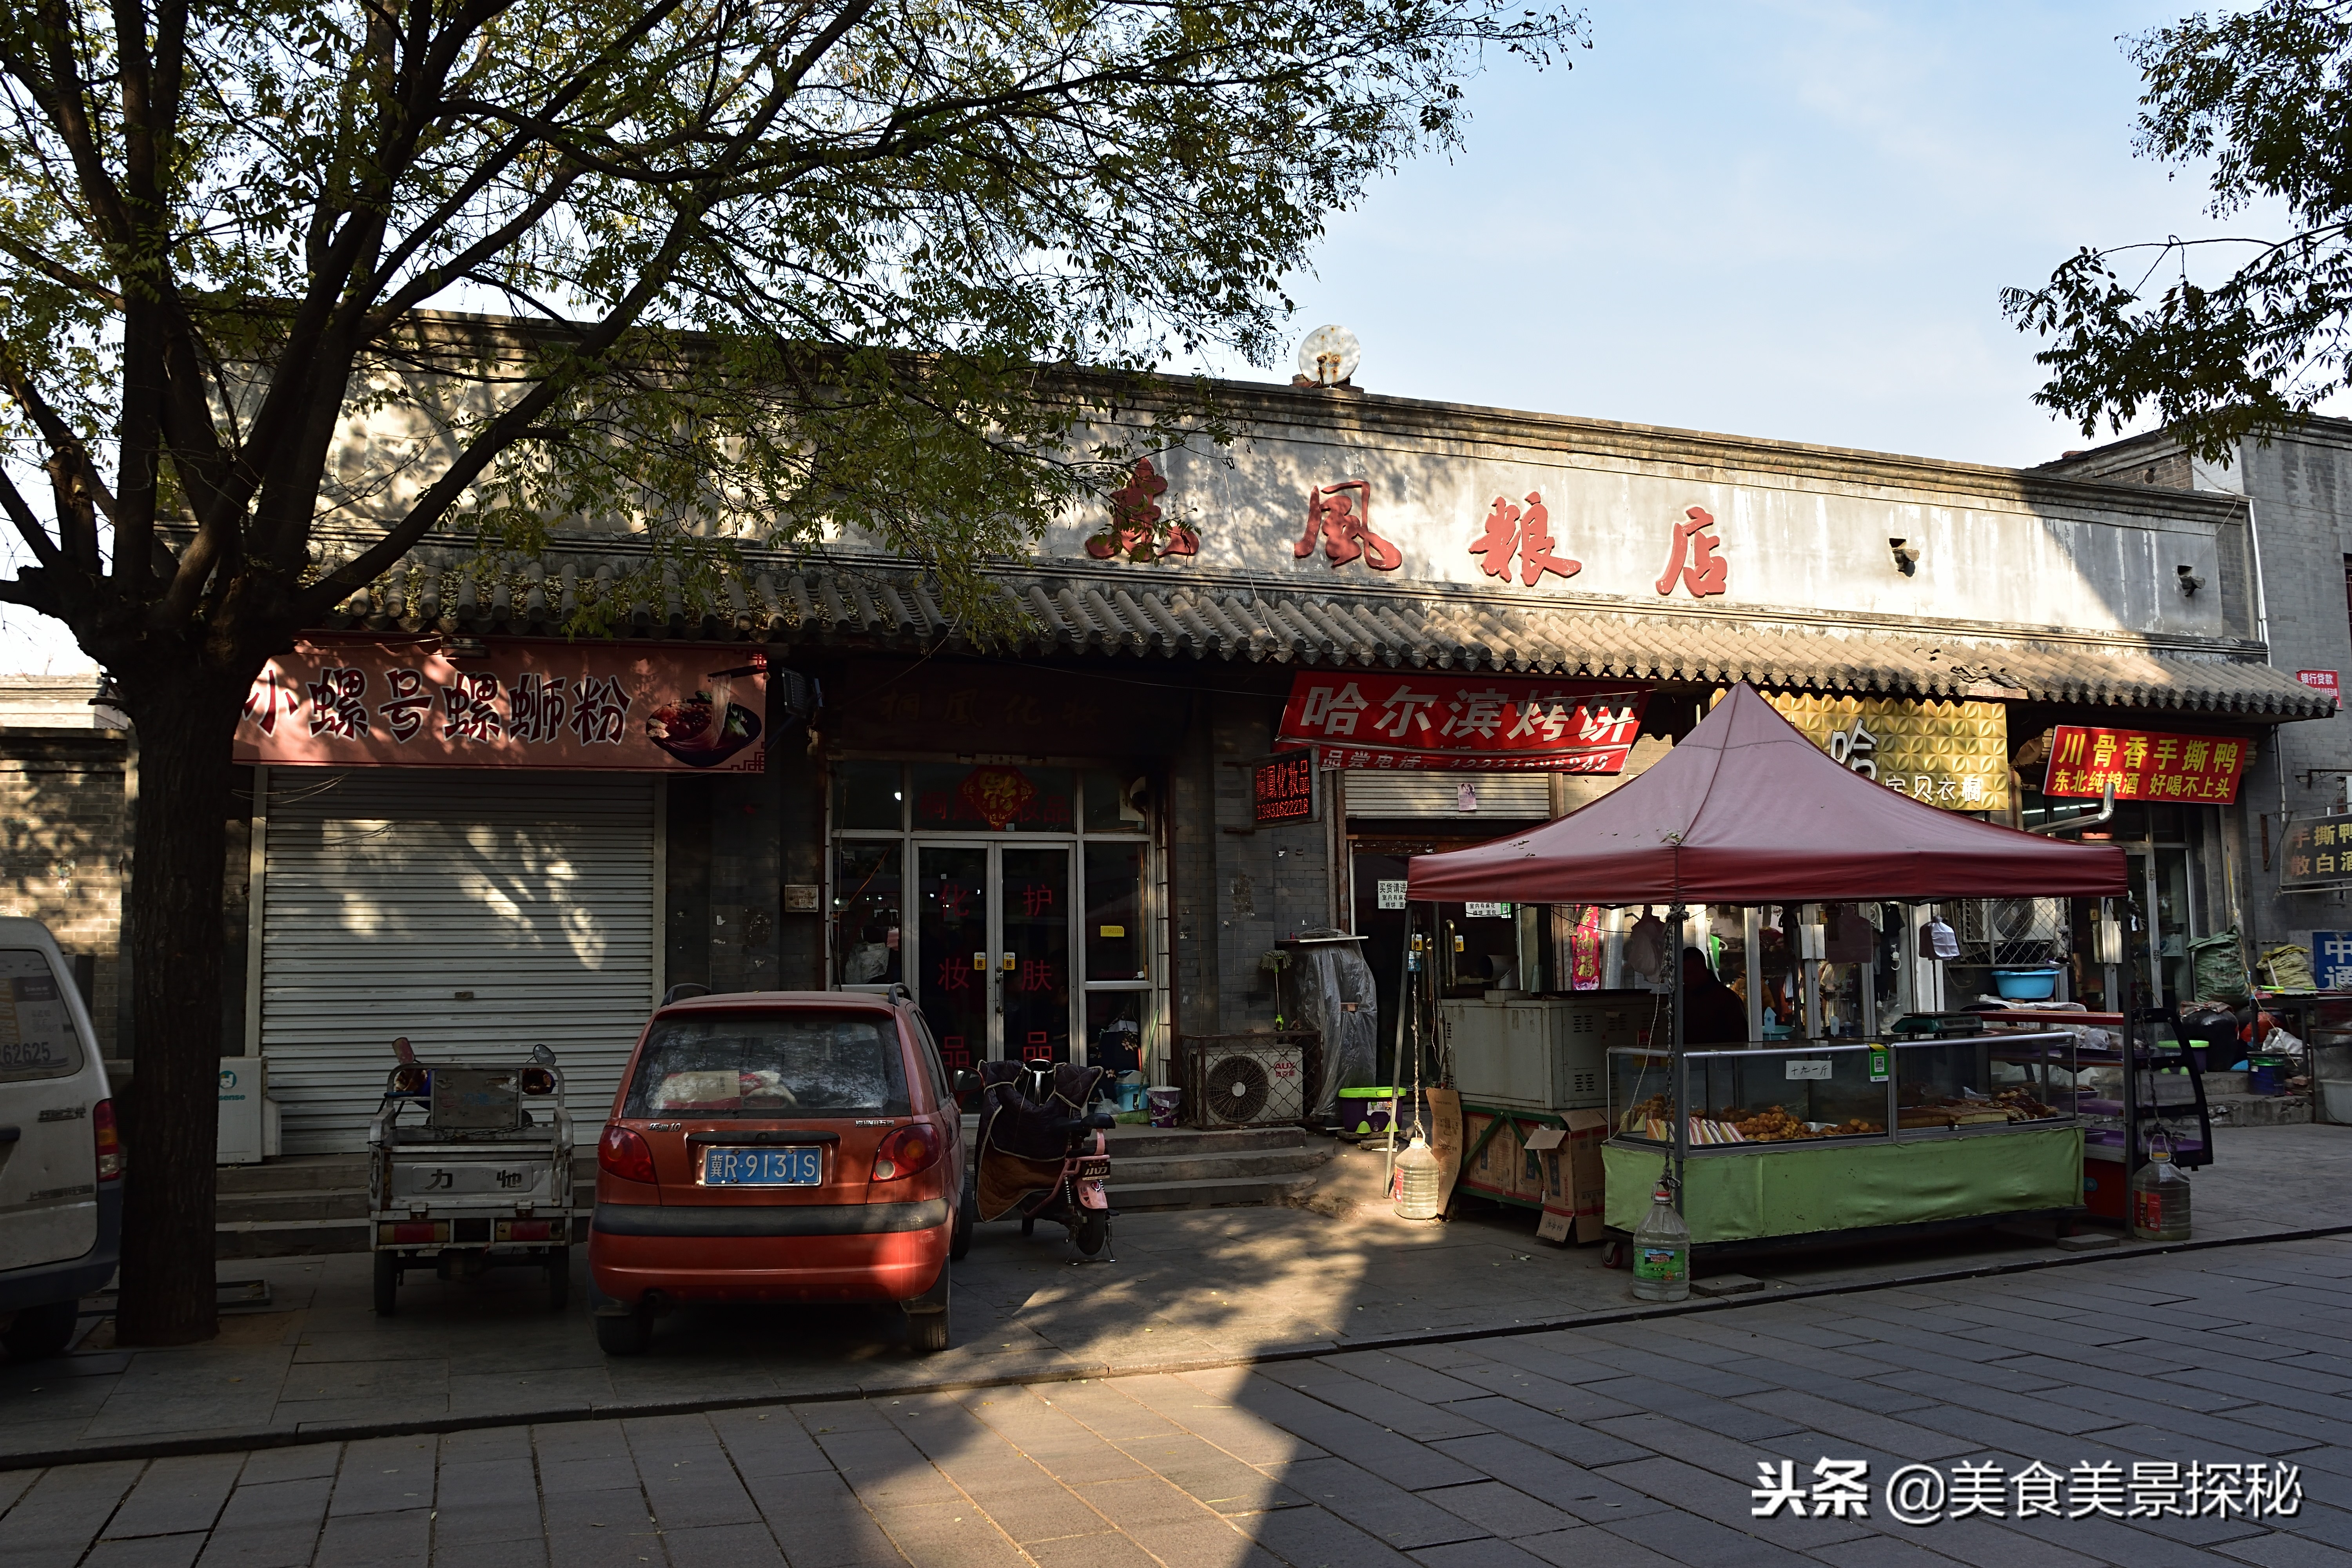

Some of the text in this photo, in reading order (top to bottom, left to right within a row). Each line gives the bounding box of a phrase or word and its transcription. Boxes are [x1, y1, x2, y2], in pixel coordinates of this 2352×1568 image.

[2300, 673, 2334, 685] 银行贷款
[242, 666, 632, 747] 小螺号螺蛳粉
[1299, 681, 1639, 744] 哈尔滨烤饼
[2057, 733, 2238, 774] 川骨香手撕鸭
[2052, 769, 2230, 799] 东北纯粮酒 好喝不上头
[1379, 882, 1407, 893] 买货请进
[1022, 884, 1053, 1061] 护肤品
